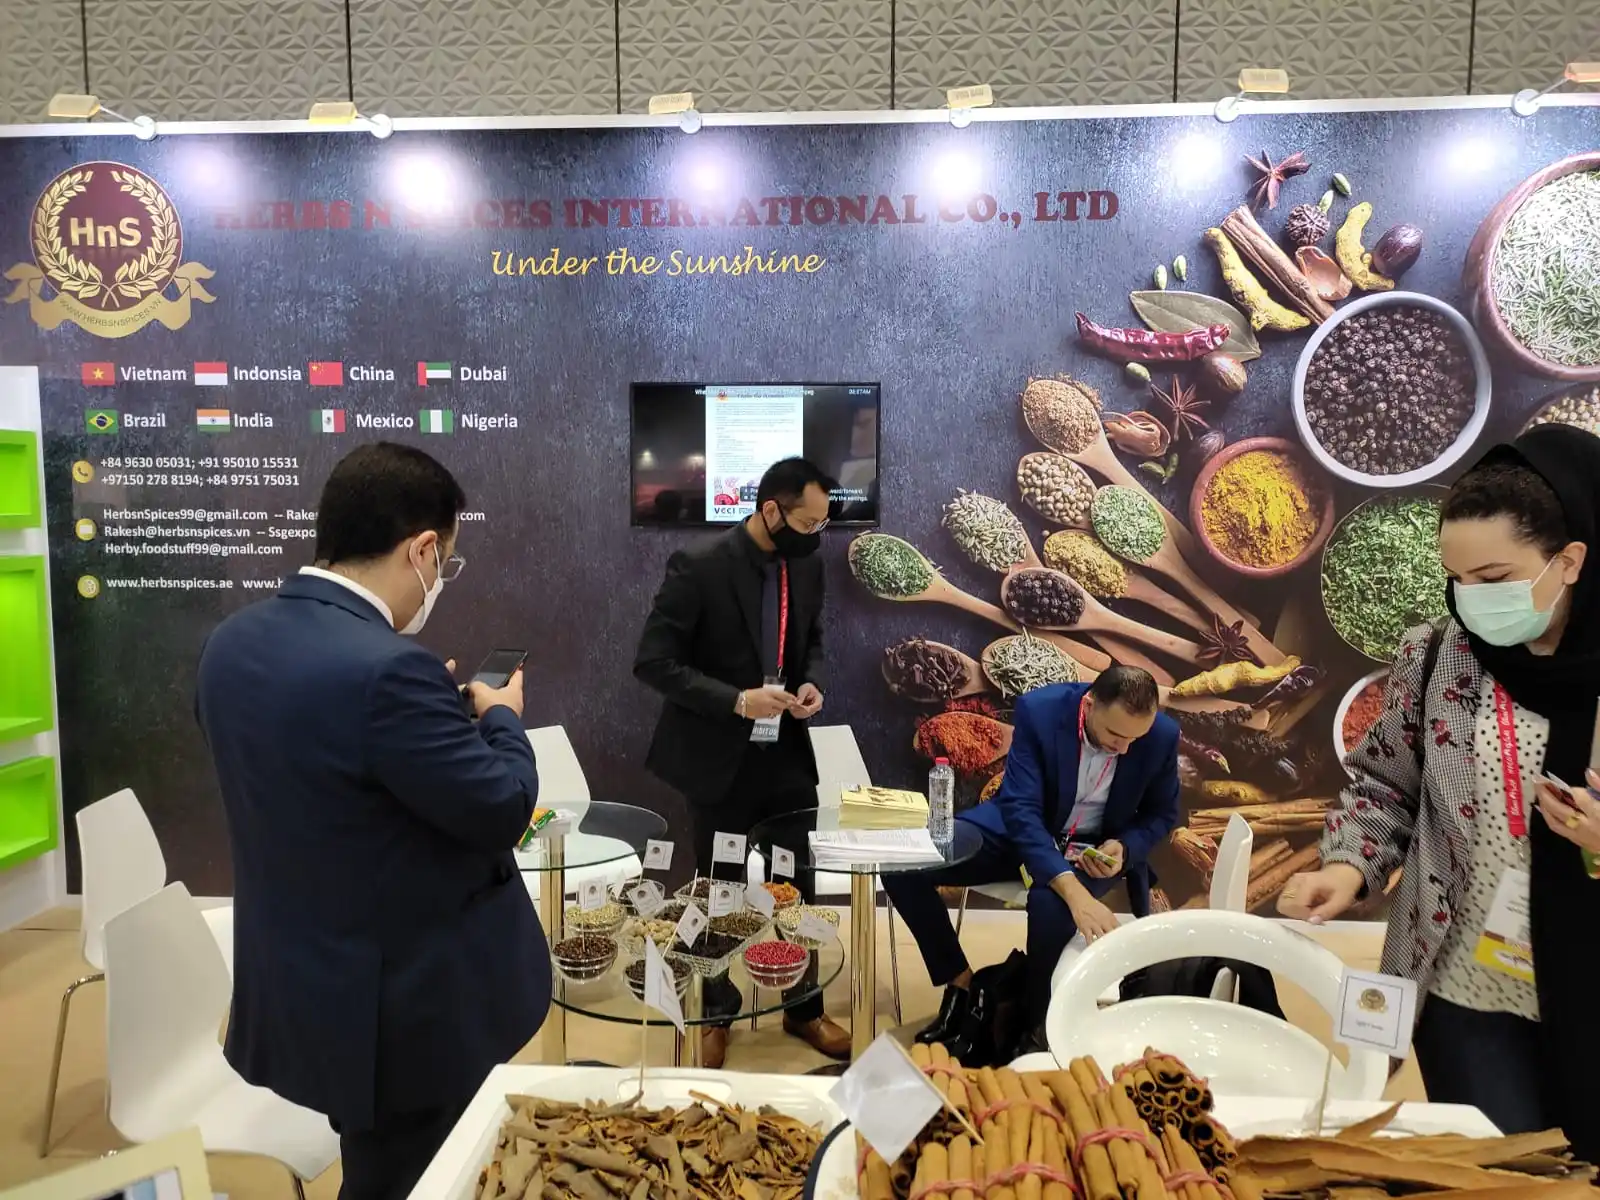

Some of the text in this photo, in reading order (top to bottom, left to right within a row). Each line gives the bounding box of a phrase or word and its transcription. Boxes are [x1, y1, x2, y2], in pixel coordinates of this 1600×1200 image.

[363, 199, 393, 231] N
[563, 193, 925, 229] INTERNATIONAL
[938, 192, 1022, 229] CO.,
[1034, 188, 1120, 222] LTD
[70, 216, 142, 248] HnS
[491, 246, 827, 276] Under the Sunshine
[120, 366, 508, 382] Vietnam Indonsia China Dubai
[123, 413, 519, 432] Brazil India Mexico Nigeria
[100, 457, 299, 470] +84 9630 05031; +91 95010 15531
[101, 474, 300, 488] +97150 278 8194; +84 9751 75031
[103, 509, 269, 524] HerbsnSpices99@gmail.com
[714, 507, 736, 515] VCCI
[104, 526, 251, 540] Rakesh@herbsnspices.vn
[105, 543, 283, 557] Herby.foodstuff99@gmail.com
[106, 578, 234, 593] www.herbsnspices.ae
